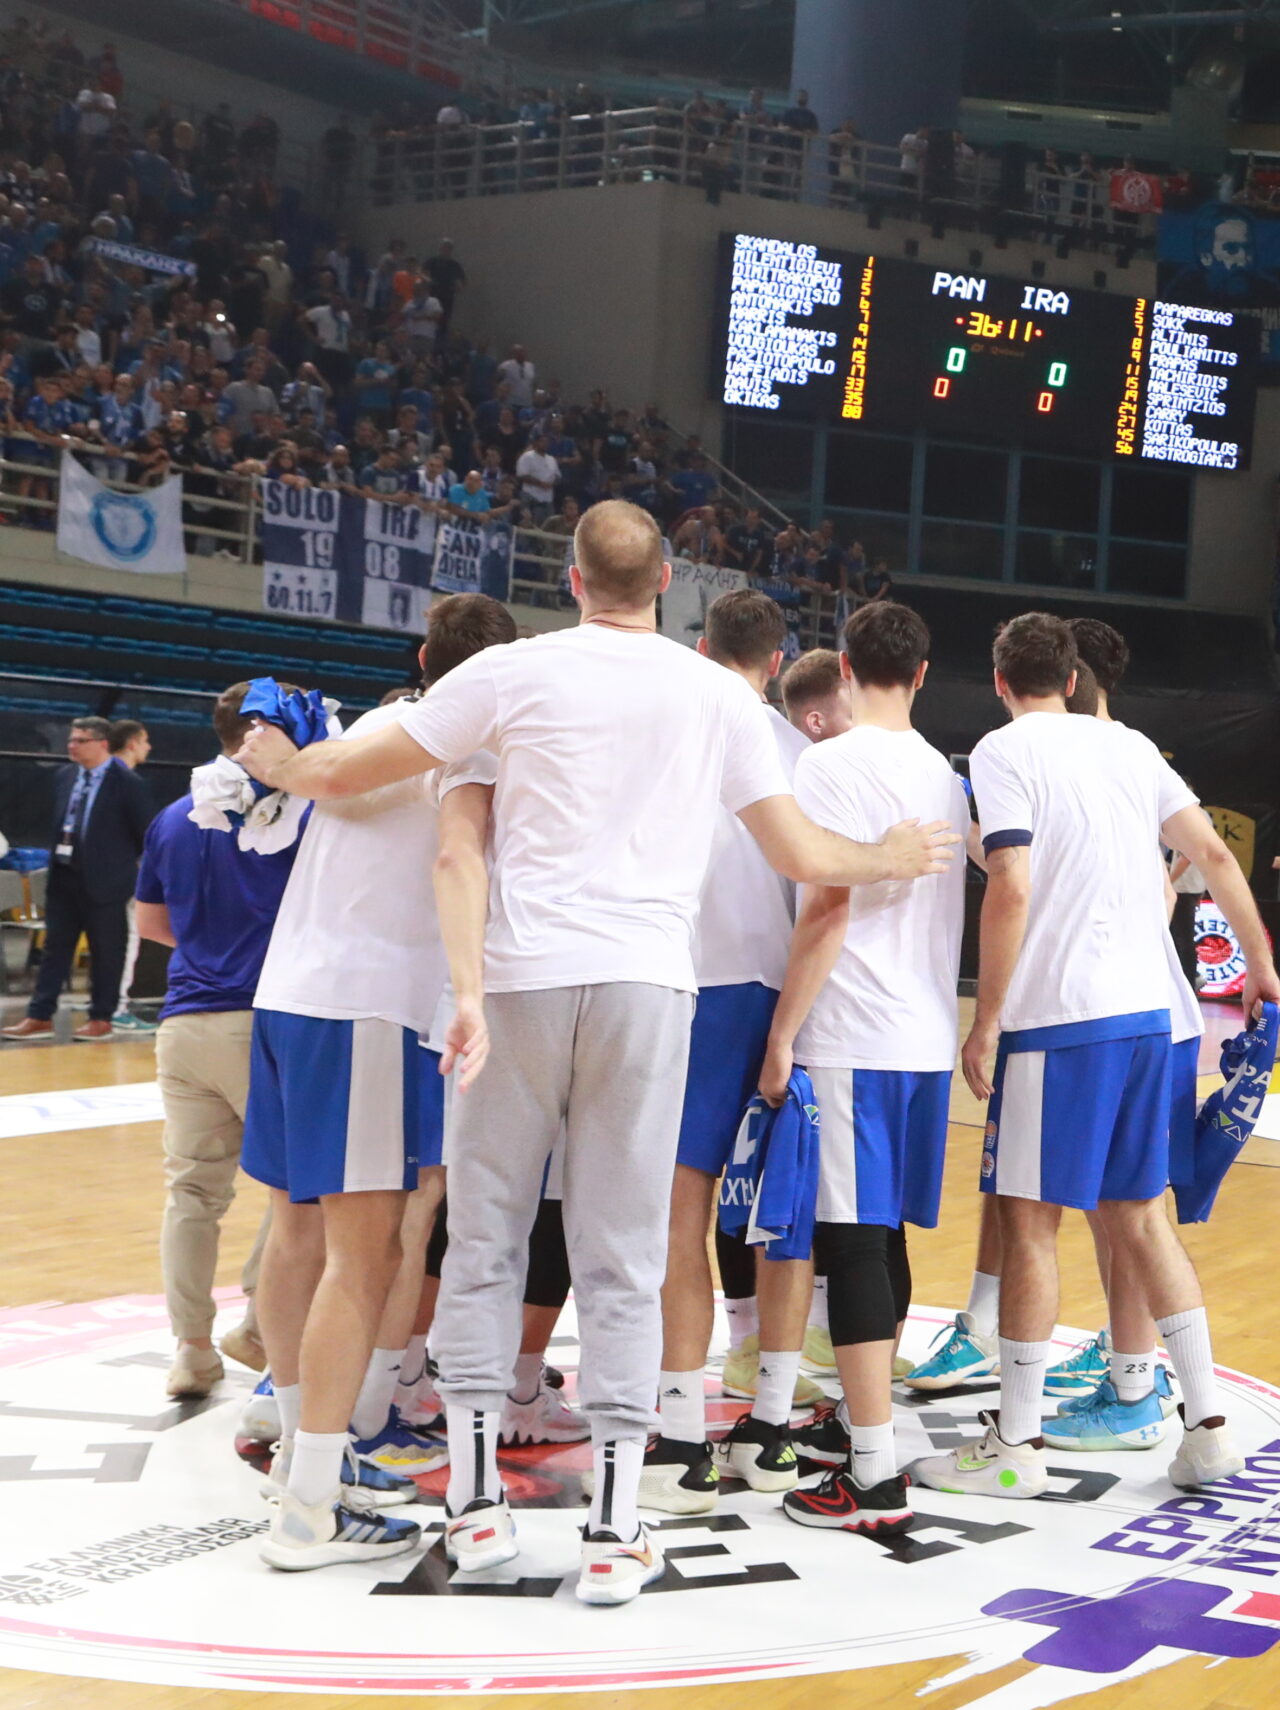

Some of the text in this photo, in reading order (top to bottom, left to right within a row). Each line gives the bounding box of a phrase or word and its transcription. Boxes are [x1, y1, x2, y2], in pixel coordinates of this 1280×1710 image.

[735, 234, 874, 268] SKANDALOS 1
[732, 262, 871, 296] DIMITRAKOPOU 5
[862, 268, 873, 282] 3
[731, 276, 871, 309] PAPADIONISIO 6
[932, 272, 1069, 315] PAN IRA
[860, 309, 871, 323] 7
[1134, 312, 1187, 331] 5 SOKK
[1135, 298, 1145, 311] 3
[1153, 301, 1233, 326] PAPAREGKAS
[858, 323, 869, 336] 9
[1135, 324, 1143, 336] 7
[1131, 337, 1142, 350] 8
[851, 350, 866, 365] 15
[946, 347, 1067, 387] 0 0
[1131, 350, 1199, 373] 9 PRAPAS
[850, 364, 866, 377] 17
[1126, 363, 1228, 390] 11 TACHIRIDIS
[844, 376, 865, 391] 33
[1125, 376, 1138, 389] 15
[723, 389, 863, 420] GKIKAS 88
[843, 390, 863, 406] 35
[934, 377, 1053, 412] 0 0
[1124, 389, 1138, 402] 19
[1118, 401, 1187, 422] 24 CARRY
[1117, 414, 1194, 436] 27 KOTTAS
[1115, 440, 1133, 455] 56
[1116, 428, 1238, 456] 45 SARIKOPOULOS
[268, 481, 335, 523] SOLO
[301, 532, 400, 580] 19 08
[1123, 1361, 1147, 1374] 23
[25, 1523, 184, 1572] ΕΛΛΗΝΙΚΗ
[57, 1516, 252, 1578] ΟΜΟΣΠΟΝΔΙΑ
[88, 1518, 272, 1584] ΚΑΛΑΘΟΣΦΑΙ
